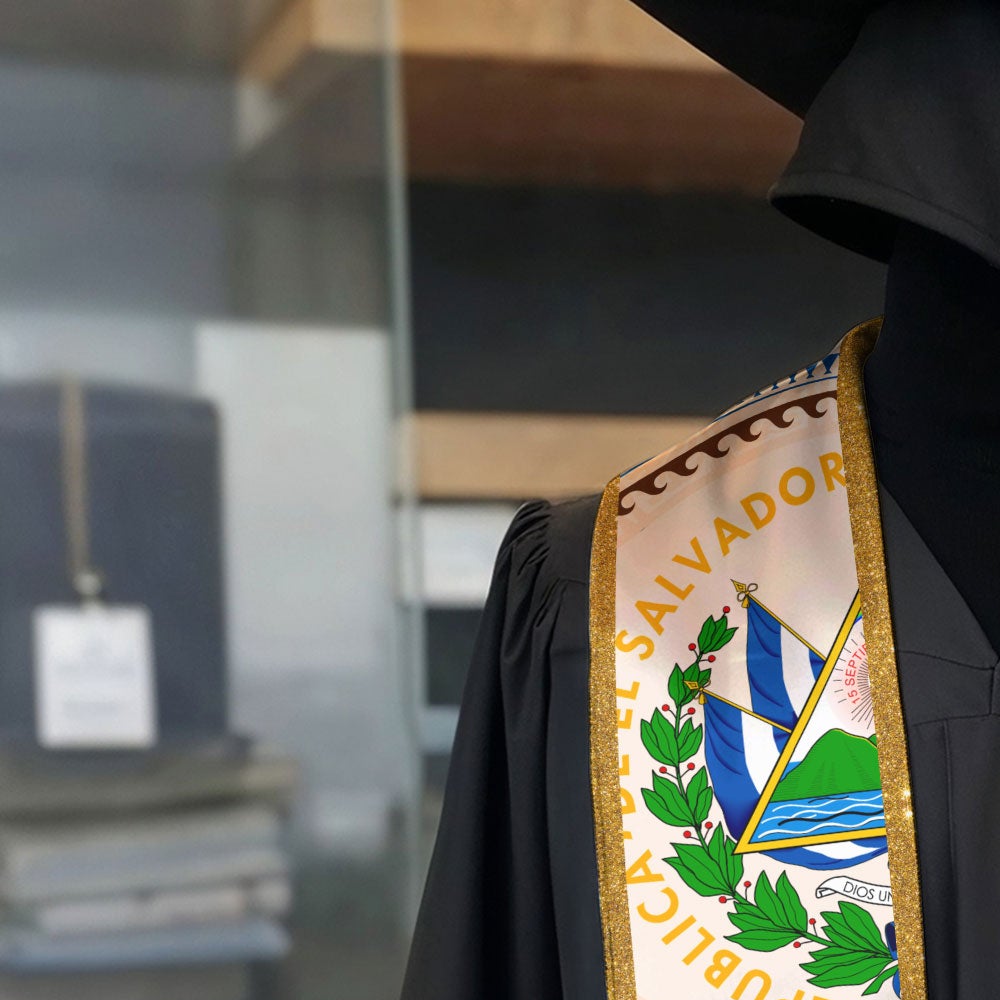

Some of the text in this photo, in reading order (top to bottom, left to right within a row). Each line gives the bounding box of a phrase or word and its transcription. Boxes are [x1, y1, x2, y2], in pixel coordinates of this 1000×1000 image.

[615, 451, 847, 662] SALVADOR
[847, 689, 860, 704] 15
[843, 881, 875, 900] DIOS
